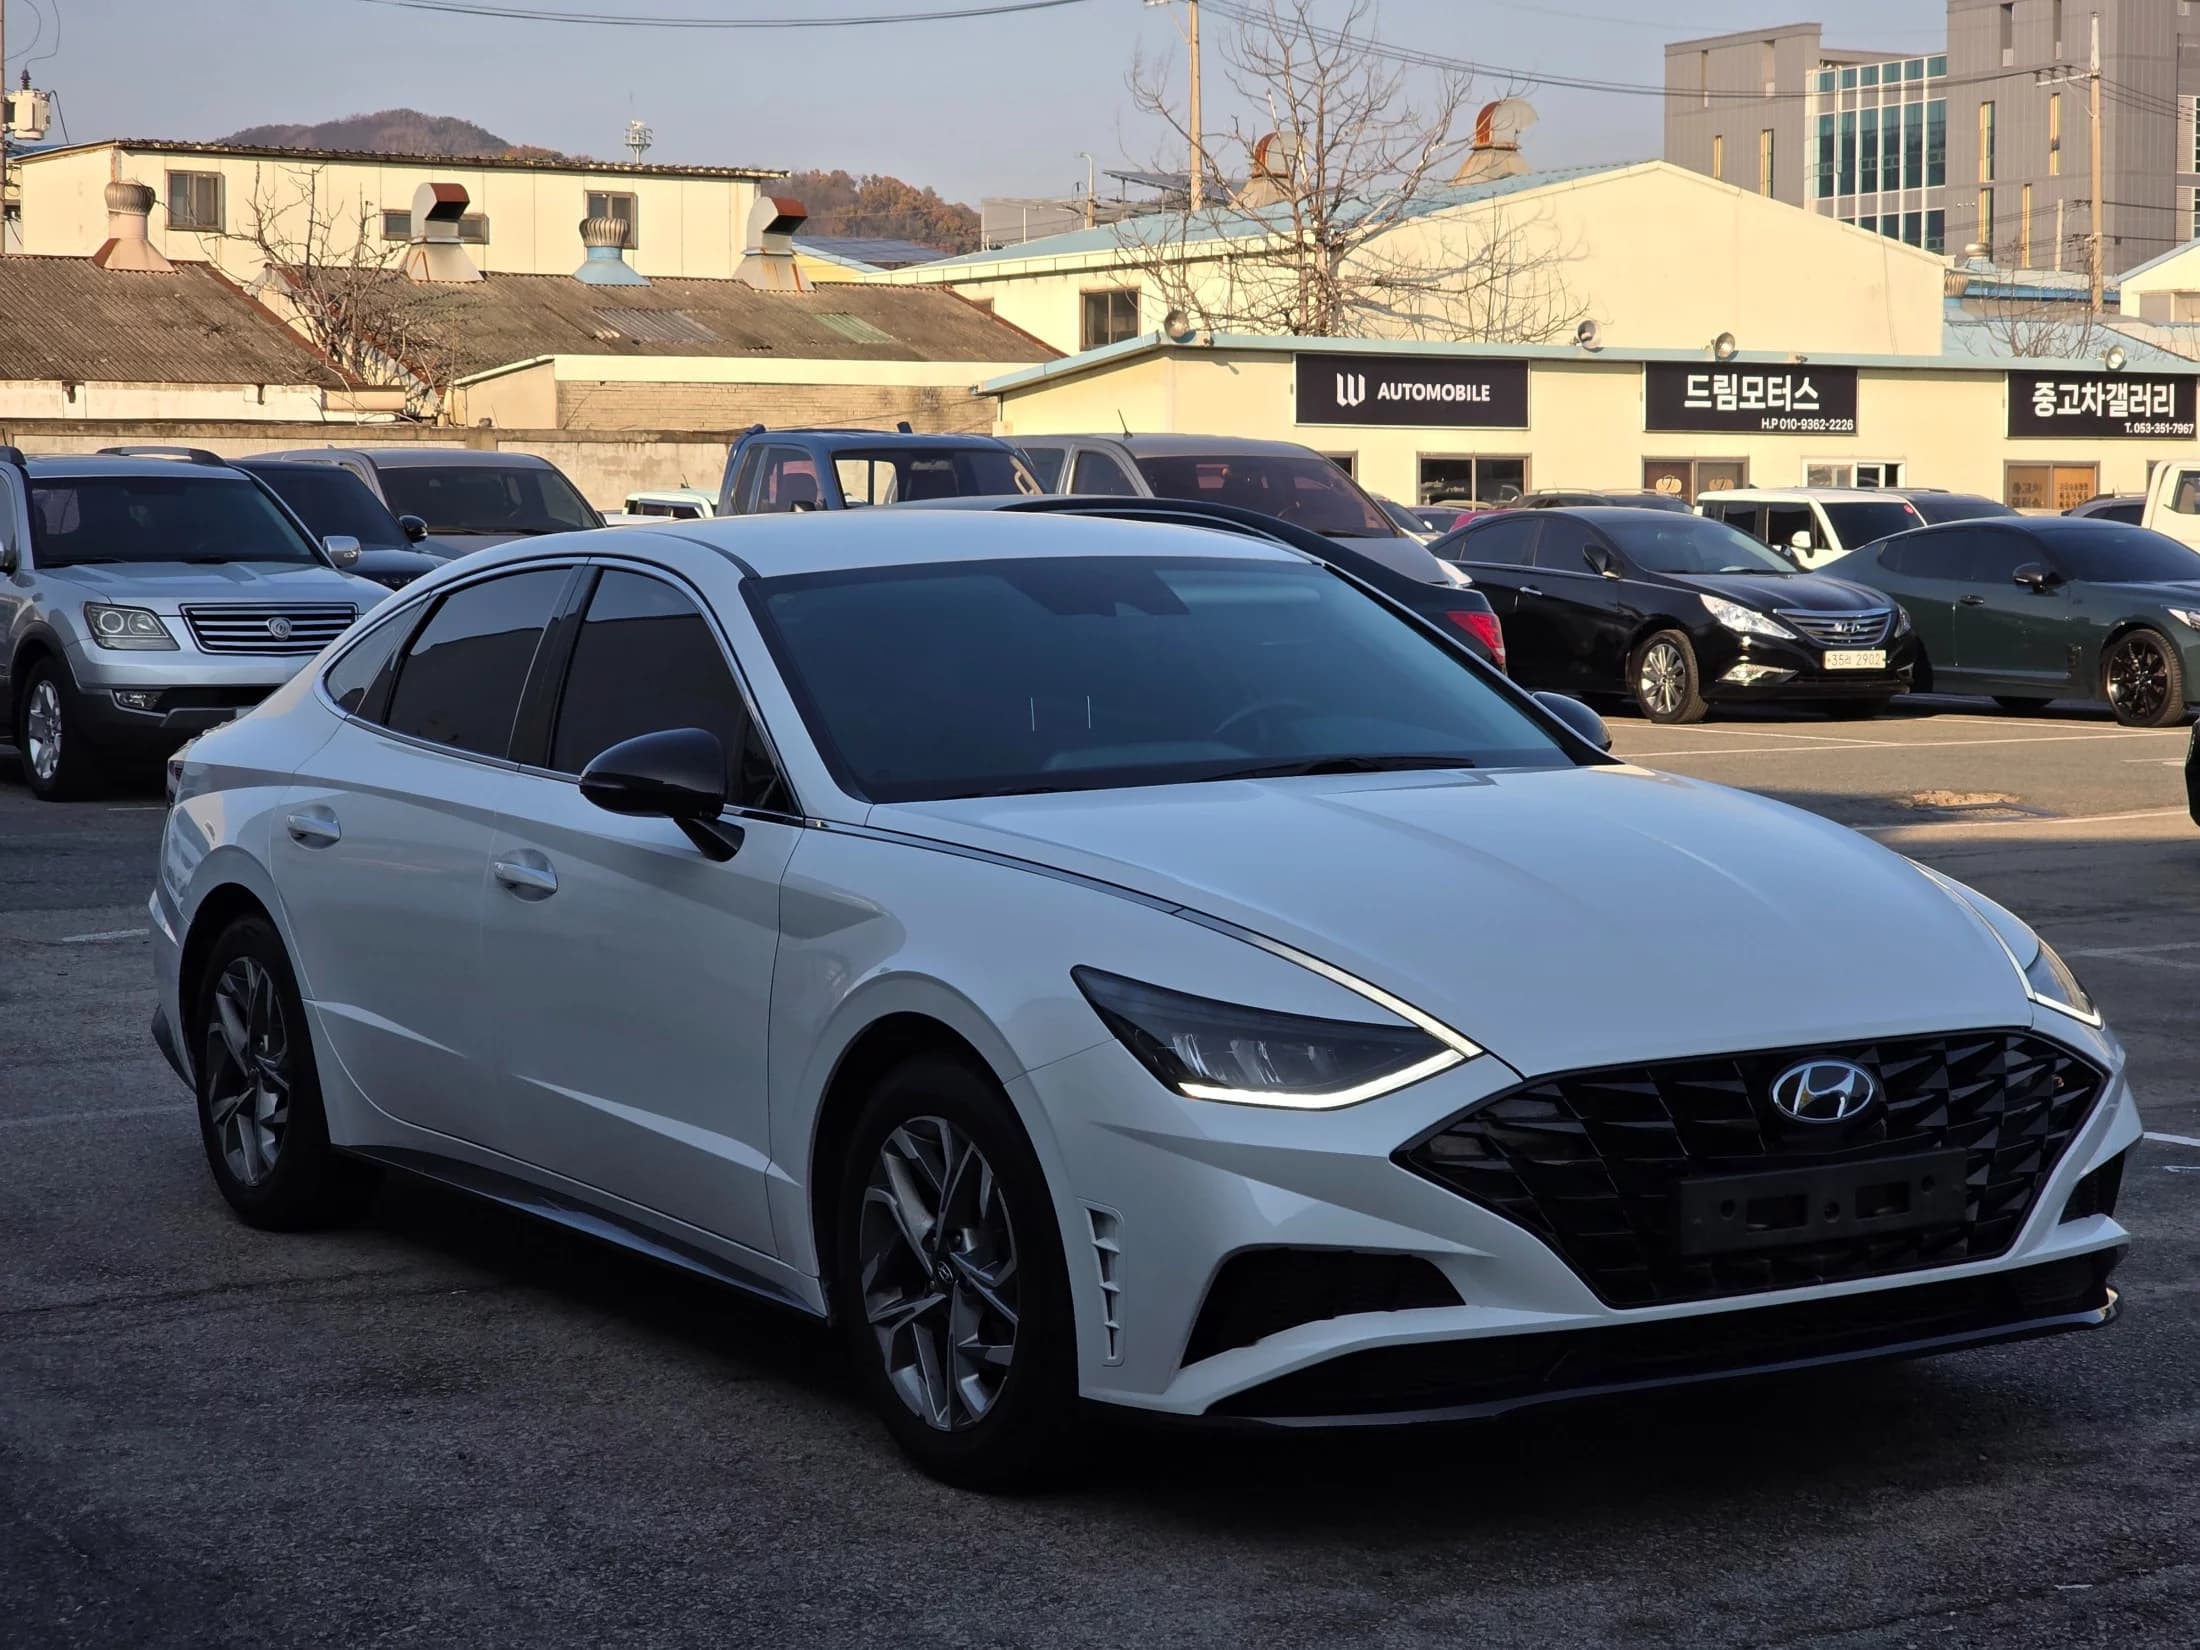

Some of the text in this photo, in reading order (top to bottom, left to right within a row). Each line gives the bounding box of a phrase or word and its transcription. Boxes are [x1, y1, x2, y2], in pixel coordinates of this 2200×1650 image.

[1377, 382, 1491, 402] AUTOMOBILE
[1684, 373, 1820, 412] 드림모터스
[2032, 382, 2175, 418] 중고차갤러리
